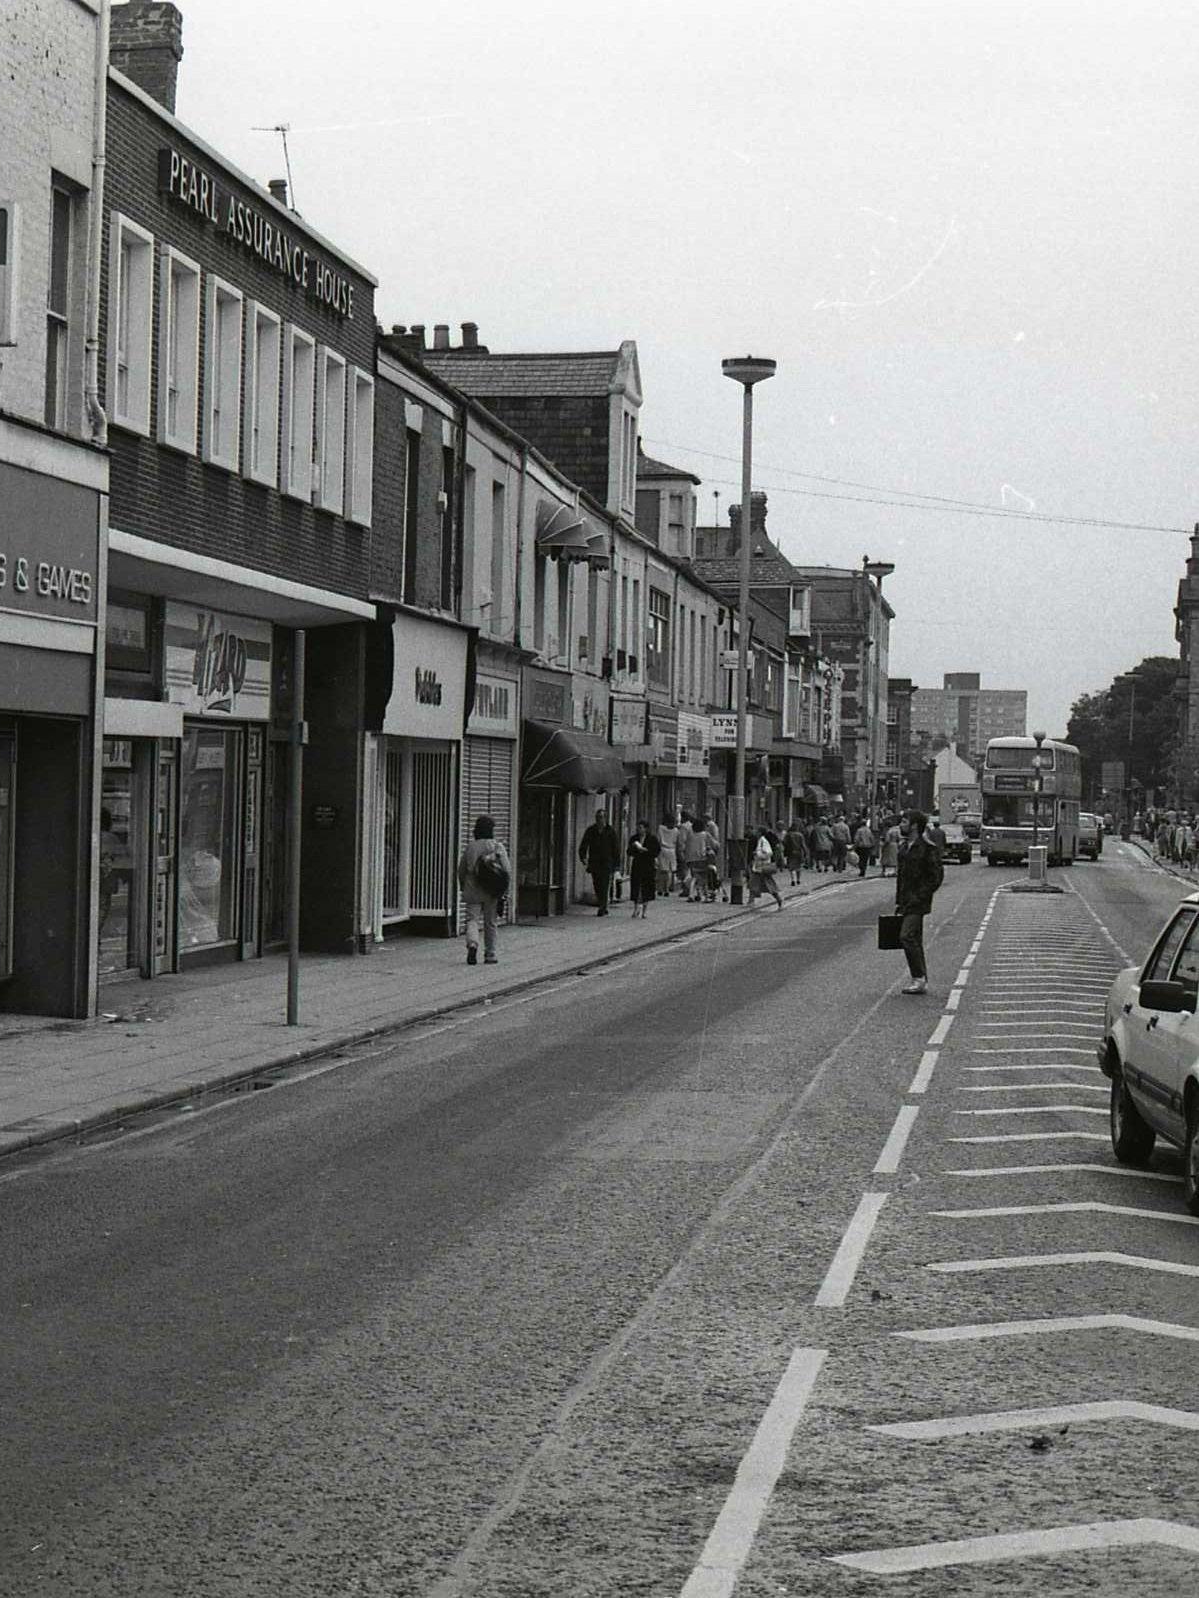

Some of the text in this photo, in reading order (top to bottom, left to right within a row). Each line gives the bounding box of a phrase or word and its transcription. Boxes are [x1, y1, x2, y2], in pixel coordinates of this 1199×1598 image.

[169, 150, 355, 319] PEARL ASSURANCE HOUSE
[15, 557, 30, 592] &
[37, 562, 93, 604] GAMES
